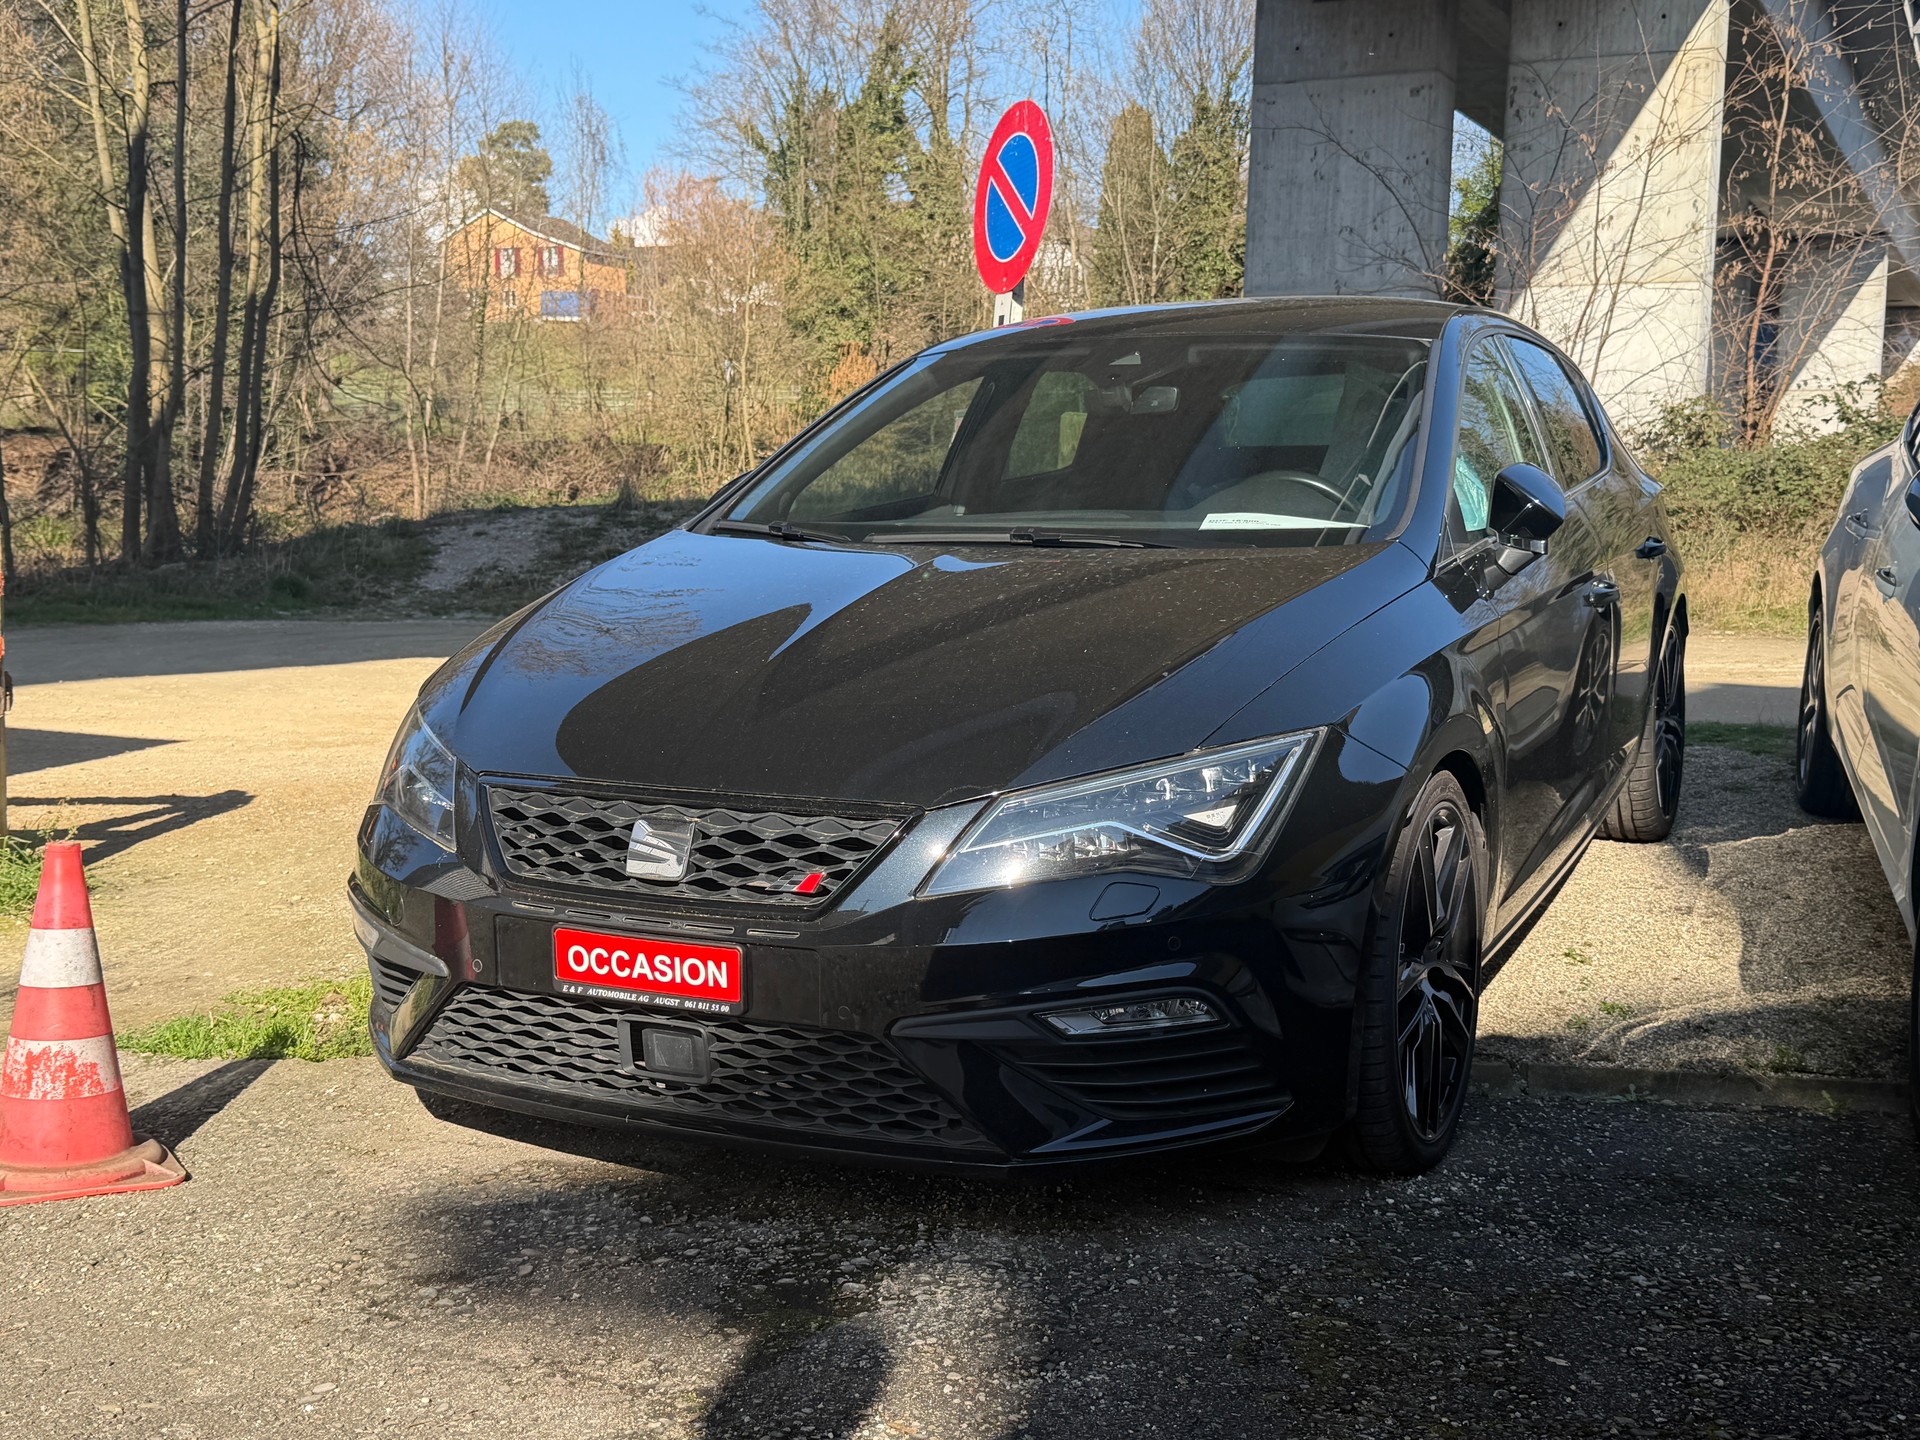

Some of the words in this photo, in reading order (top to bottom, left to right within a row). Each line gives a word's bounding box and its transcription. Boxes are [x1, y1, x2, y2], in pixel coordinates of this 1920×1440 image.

[567, 944, 728, 988] OCCASION
[562, 984, 569, 992] E
[577, 986, 584, 994] F
[587, 988, 637, 1001] AUTOMOBILE
[637, 995, 650, 1003] AG
[653, 996, 680, 1007] AUGST
[684, 1000, 697, 1009] 061
[697, 1002, 710, 1010] 811
